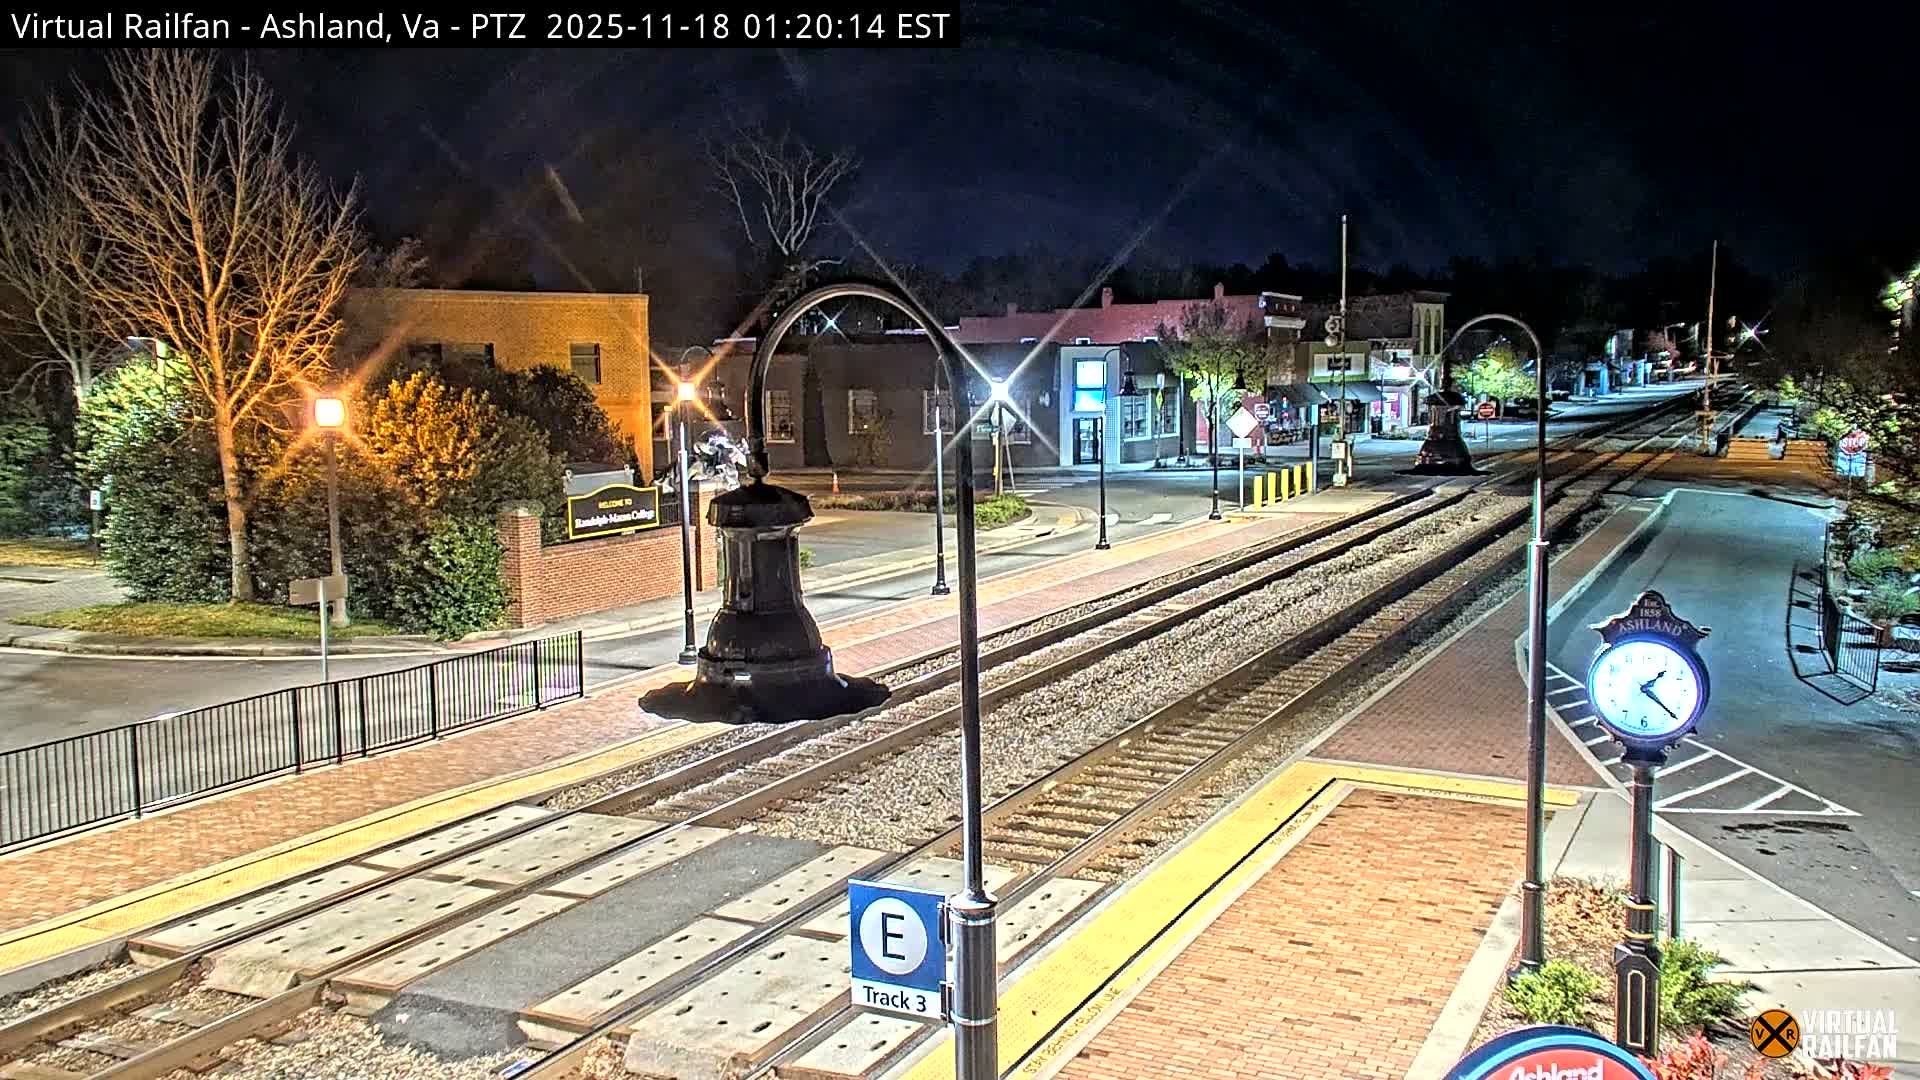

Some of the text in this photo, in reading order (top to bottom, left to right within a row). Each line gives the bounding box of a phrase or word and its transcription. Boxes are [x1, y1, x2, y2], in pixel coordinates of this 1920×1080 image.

[1841, 437, 1865, 447] STOP
[1619, 618, 1682, 637] ASHLAND
[881, 911, 906, 961] E
[862, 985, 927, 1013] Track 3
